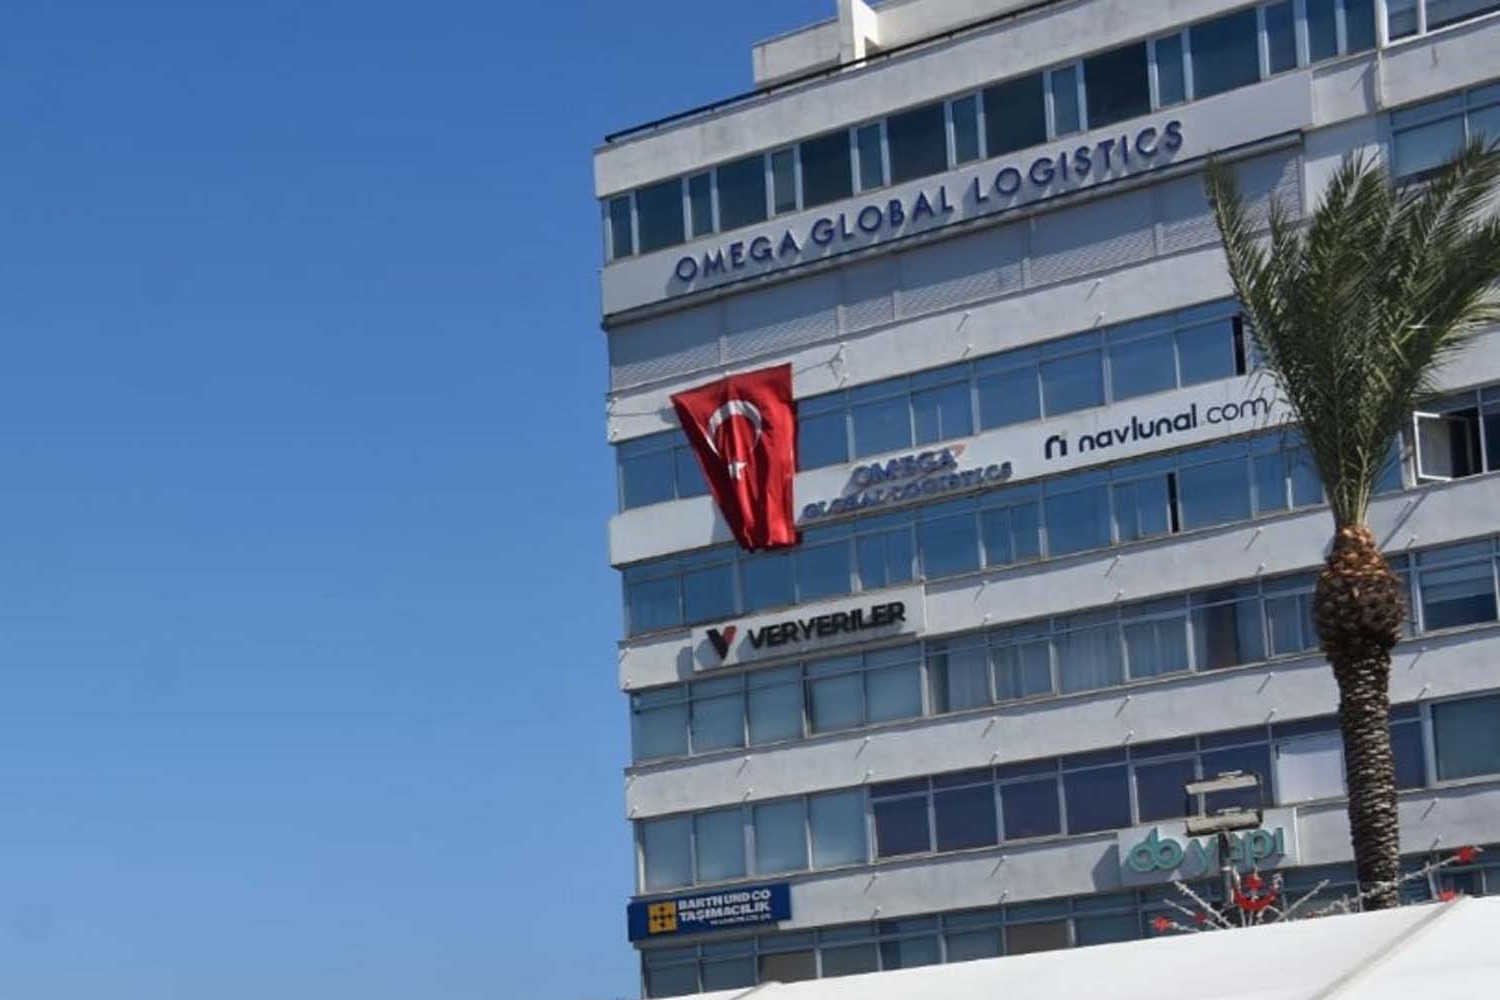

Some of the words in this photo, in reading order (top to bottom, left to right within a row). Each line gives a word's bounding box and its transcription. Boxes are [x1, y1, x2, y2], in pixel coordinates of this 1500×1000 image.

[676, 229, 799, 282] OMEGA
[811, 186, 954, 245] GLOBAL
[974, 121, 1183, 203] LOGISTICS
[851, 448, 958, 485] OMEGA
[748, 602, 906, 649] VERYERILER
[678, 896, 723, 910] BARTH
[724, 893, 751, 904] UND
[750, 889, 771, 902] CO
